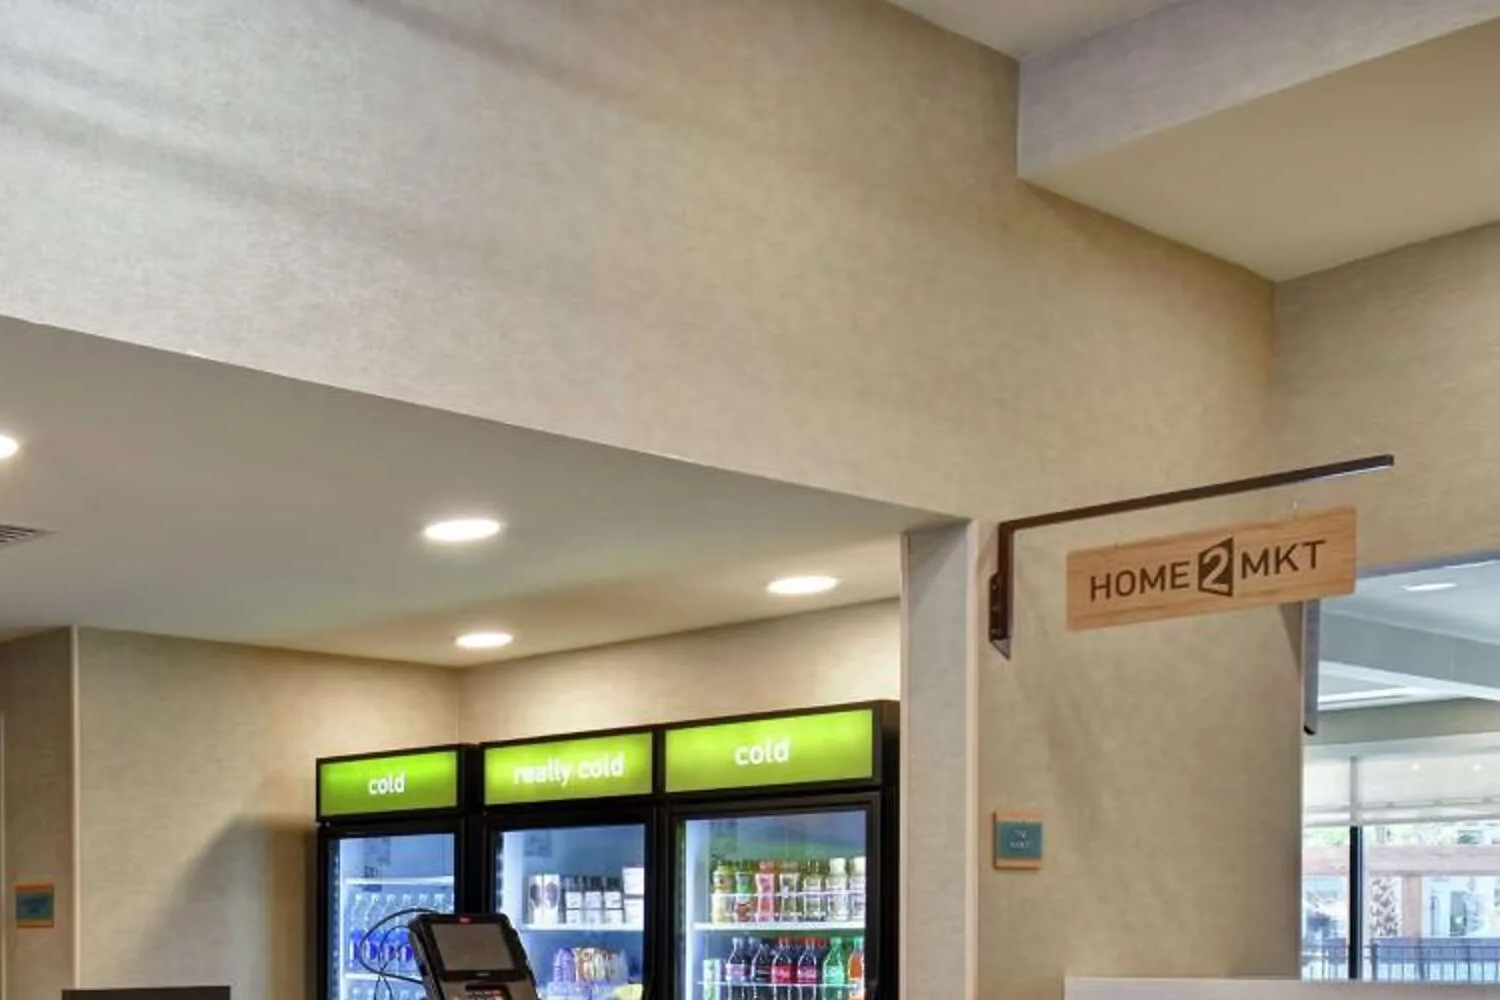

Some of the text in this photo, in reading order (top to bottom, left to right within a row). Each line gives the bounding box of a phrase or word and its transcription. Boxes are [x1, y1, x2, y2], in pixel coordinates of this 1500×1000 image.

[1089, 560, 1191, 602] HOME
[1241, 539, 1326, 580] MKT
[734, 736, 791, 766] cold
[368, 771, 405, 795] cold
[513, 752, 625, 787] really cold
